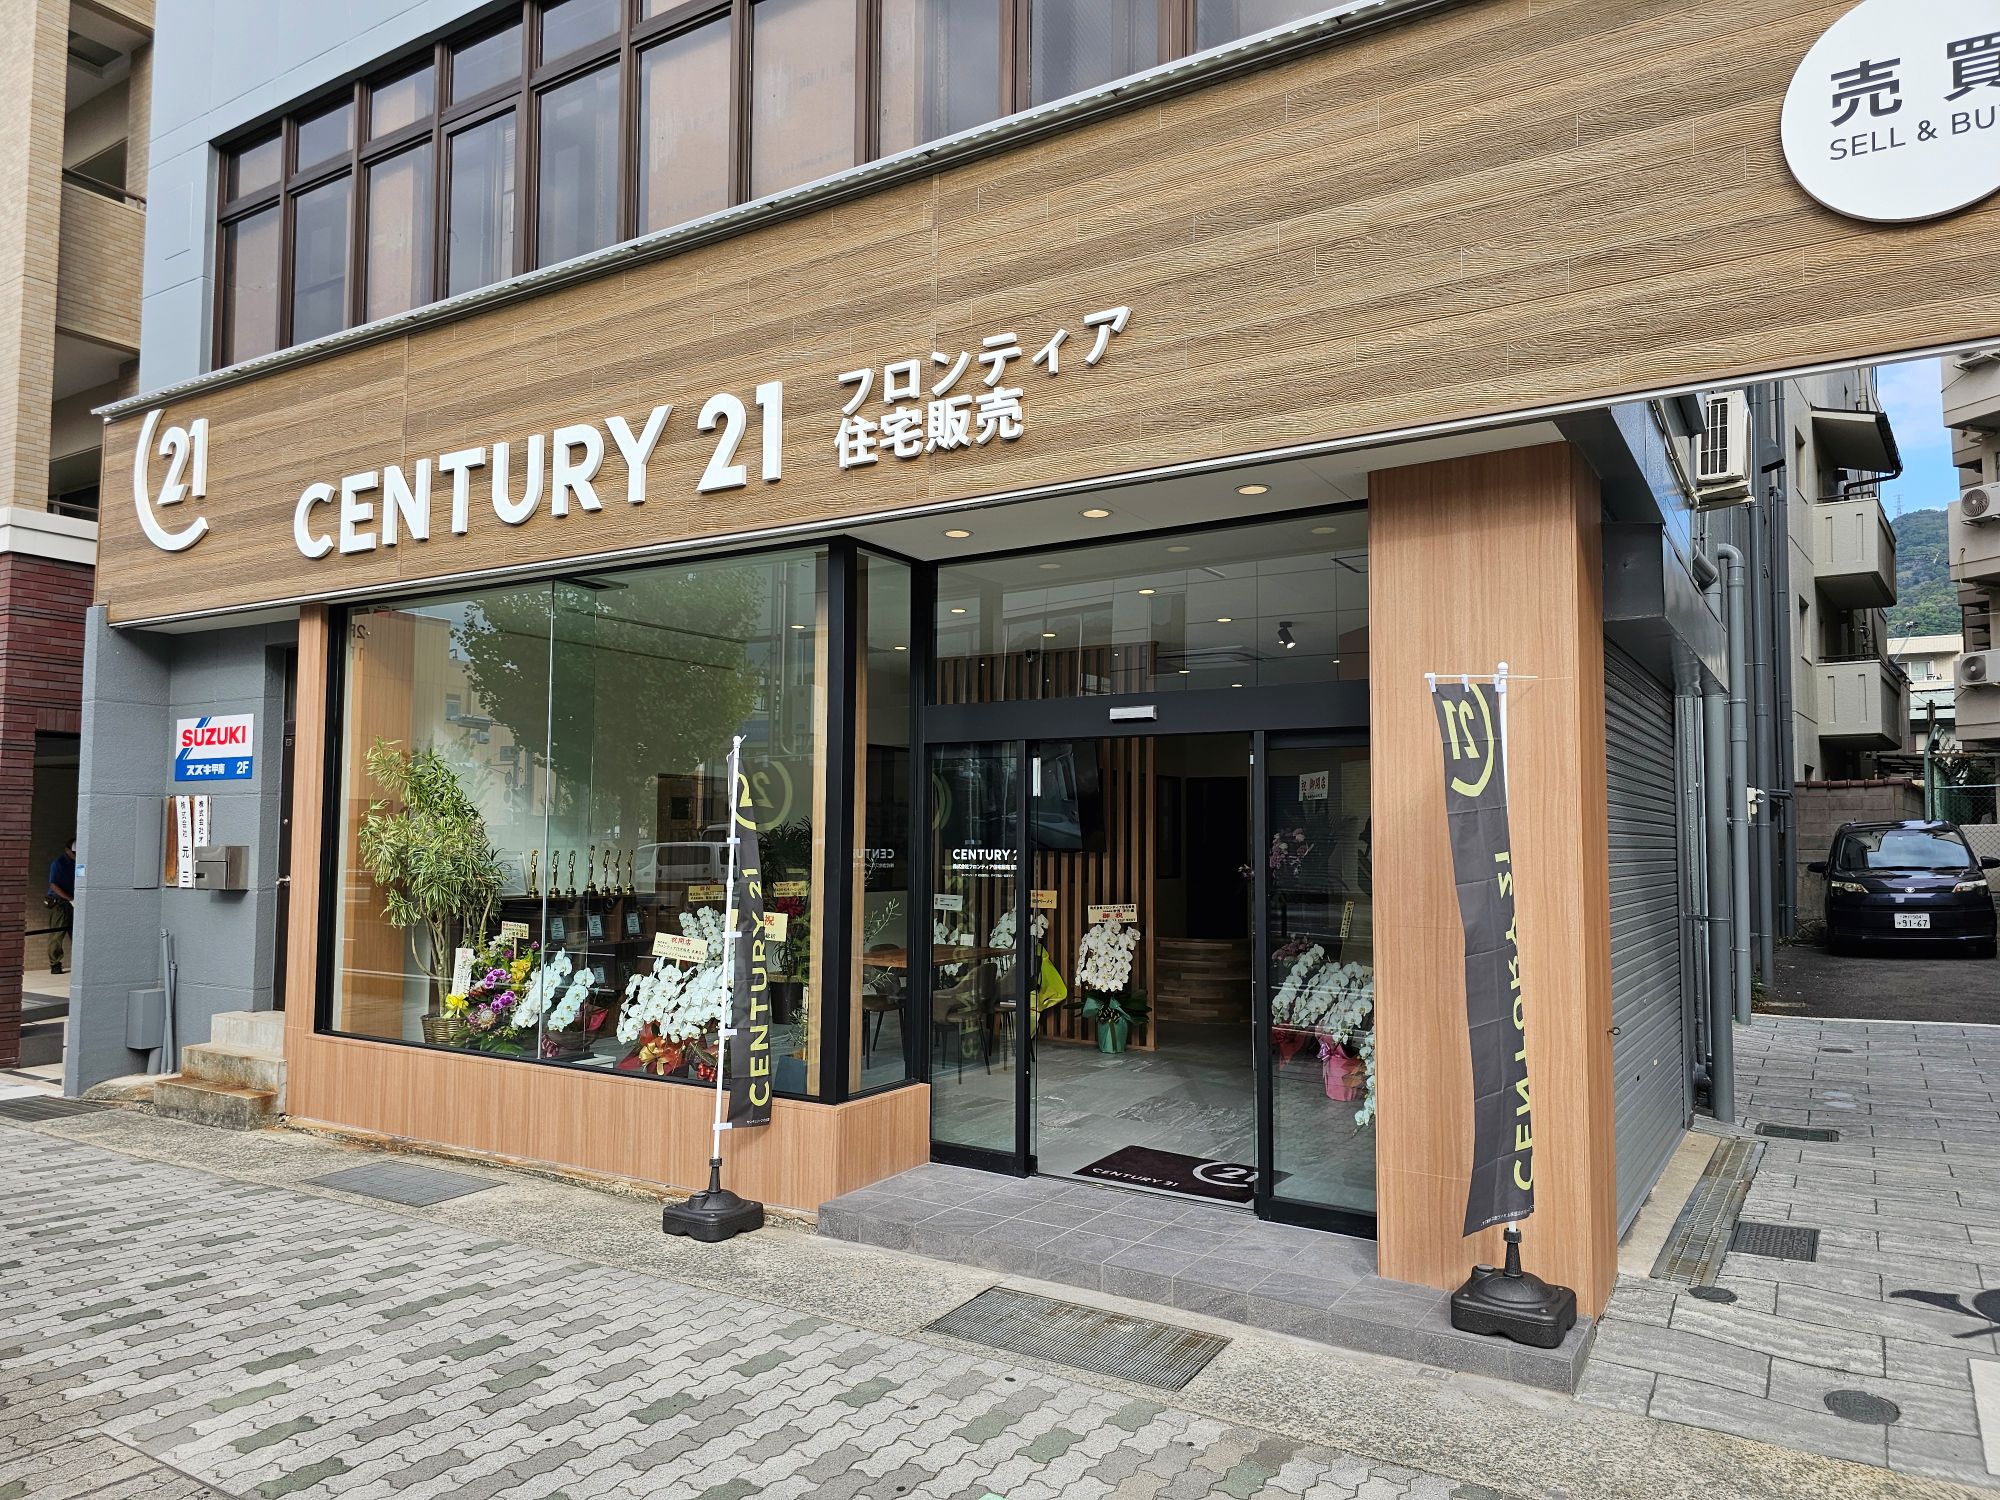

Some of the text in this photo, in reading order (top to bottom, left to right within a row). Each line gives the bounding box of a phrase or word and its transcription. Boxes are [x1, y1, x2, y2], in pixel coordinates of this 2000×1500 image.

[1830, 105, 2000, 161] SELL & BU
[838, 306, 1132, 416] フロンティア
[834, 387, 1025, 469] 住宅販売
[294, 381, 783, 559] CENTURY 21
[182, 726, 246, 747] SUZUKI
[237, 761, 249, 775] 2F
[952, 848, 1010, 861] CENTURY
[742, 868, 762, 899] 21
[749, 913, 770, 1107] CENTURY
[1092, 1168, 1162, 1185] CENTURY
